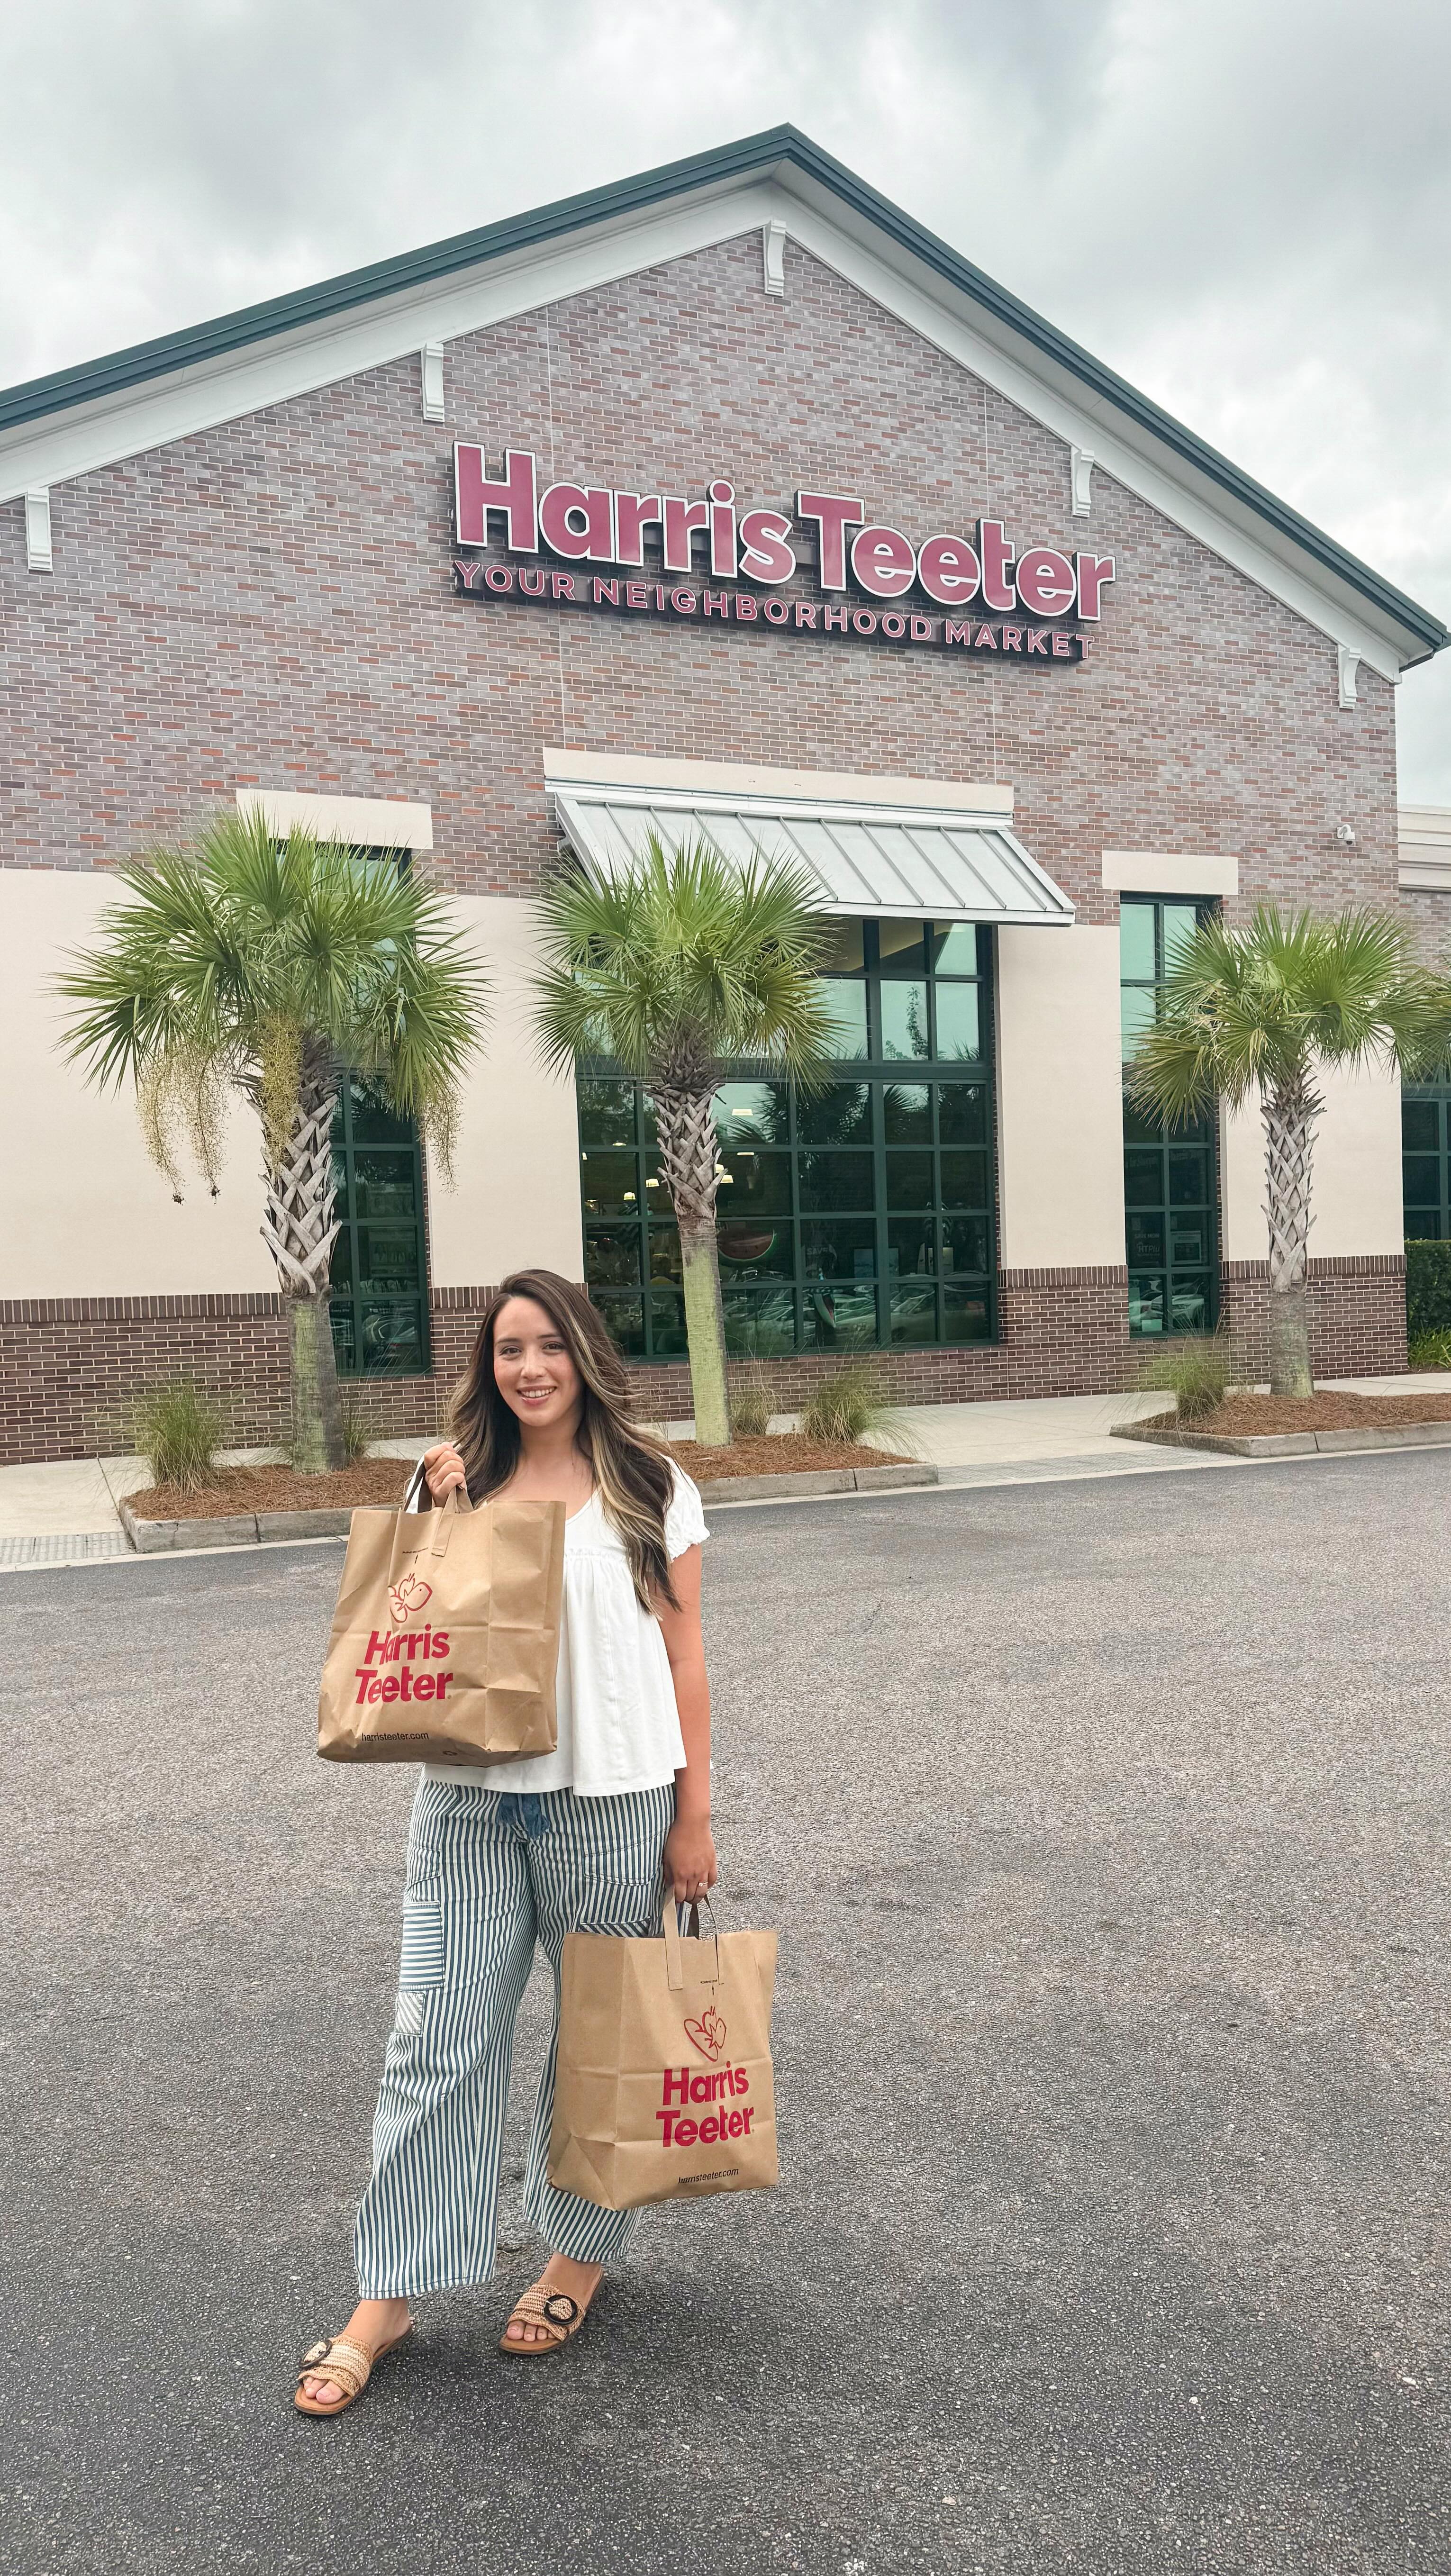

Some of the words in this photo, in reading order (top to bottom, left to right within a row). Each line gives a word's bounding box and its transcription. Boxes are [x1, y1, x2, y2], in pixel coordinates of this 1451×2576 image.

[453, 440, 797, 584] Harris
[796, 490, 1116, 621] Teeter
[453, 560, 575, 600] YOUR
[593, 576, 932, 641] NEIGHBORHOOD
[945, 618, 1095, 659] MARKET
[363, 1624, 450, 1665] Harris
[354, 1666, 453, 1704] Teeter
[362, 1732, 429, 1741] harristeeter.com
[662, 2060, 749, 2106] Harris
[656, 2105, 754, 2147] Teeter
[678, 2169, 739, 2184] harristeeter.com
